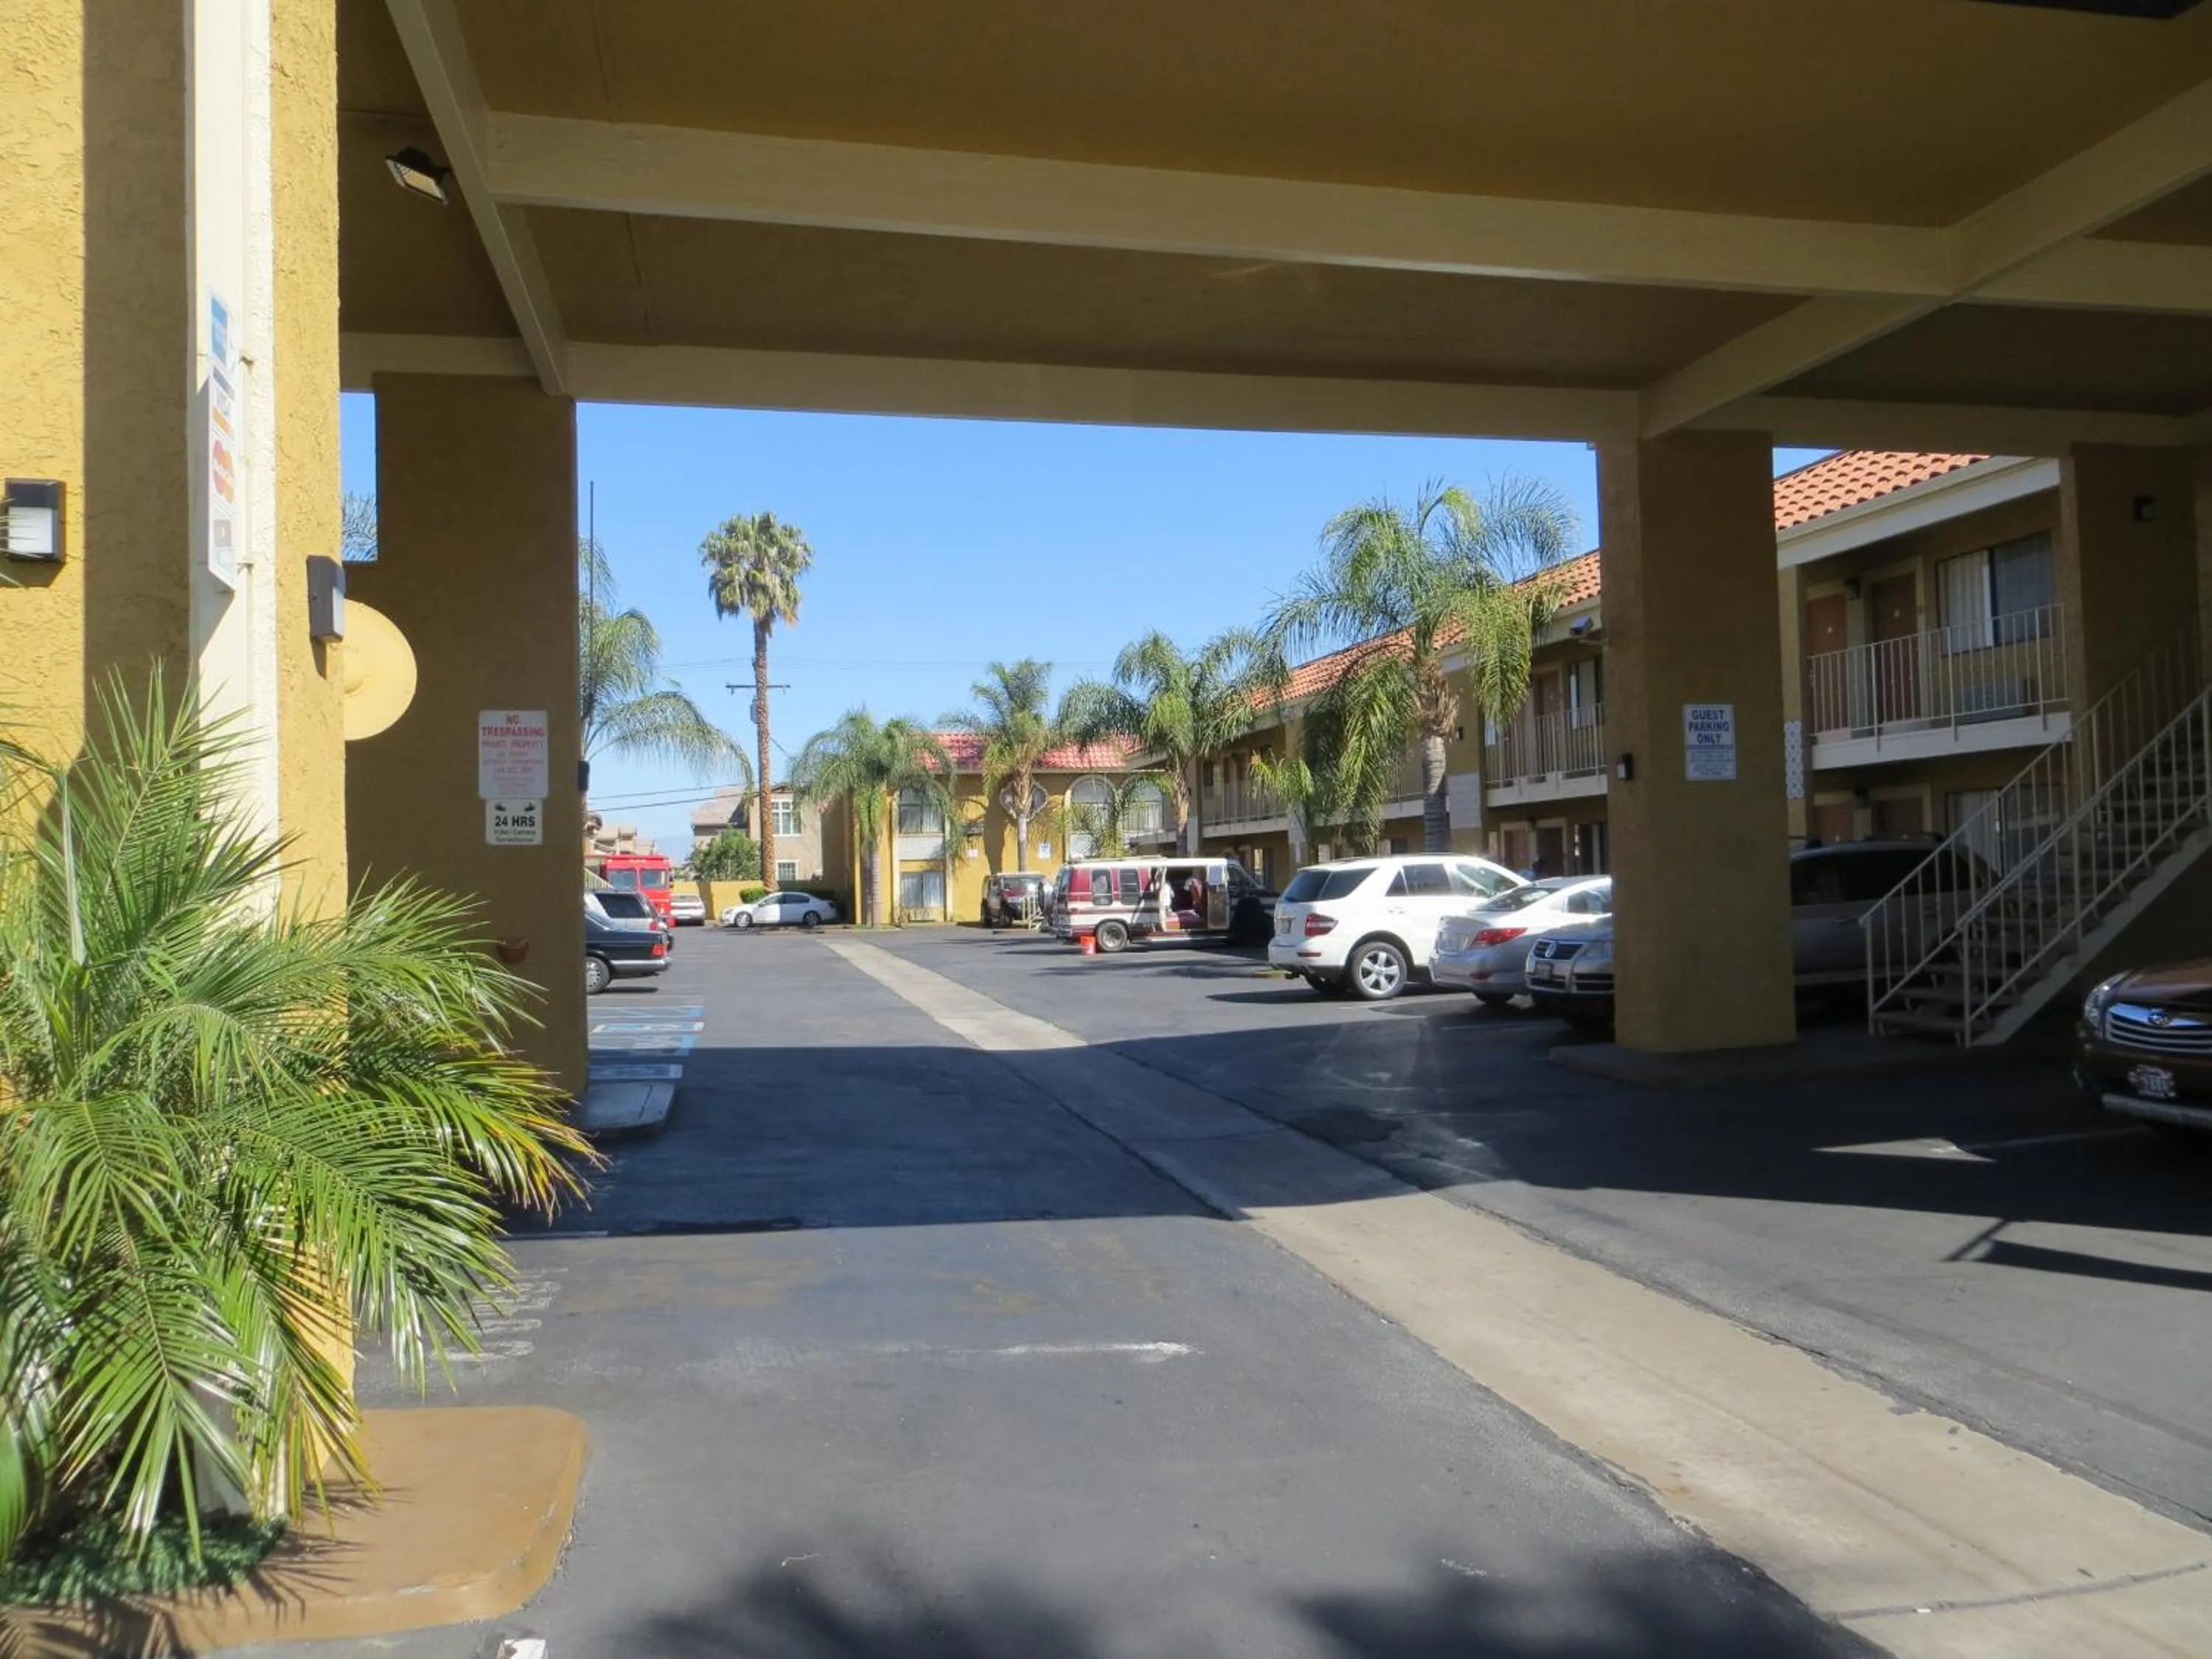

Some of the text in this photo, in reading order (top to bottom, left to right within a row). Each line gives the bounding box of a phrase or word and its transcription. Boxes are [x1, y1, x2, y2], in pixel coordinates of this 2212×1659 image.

[507, 714, 520, 726] NO
[1692, 709, 1724, 720] GUEST
[481, 726, 546, 737] TRESPASSING
[1688, 721, 1730, 732] PARKING
[1697, 733, 1721, 744] ONLY
[495, 815, 535, 827] 24 HRS
